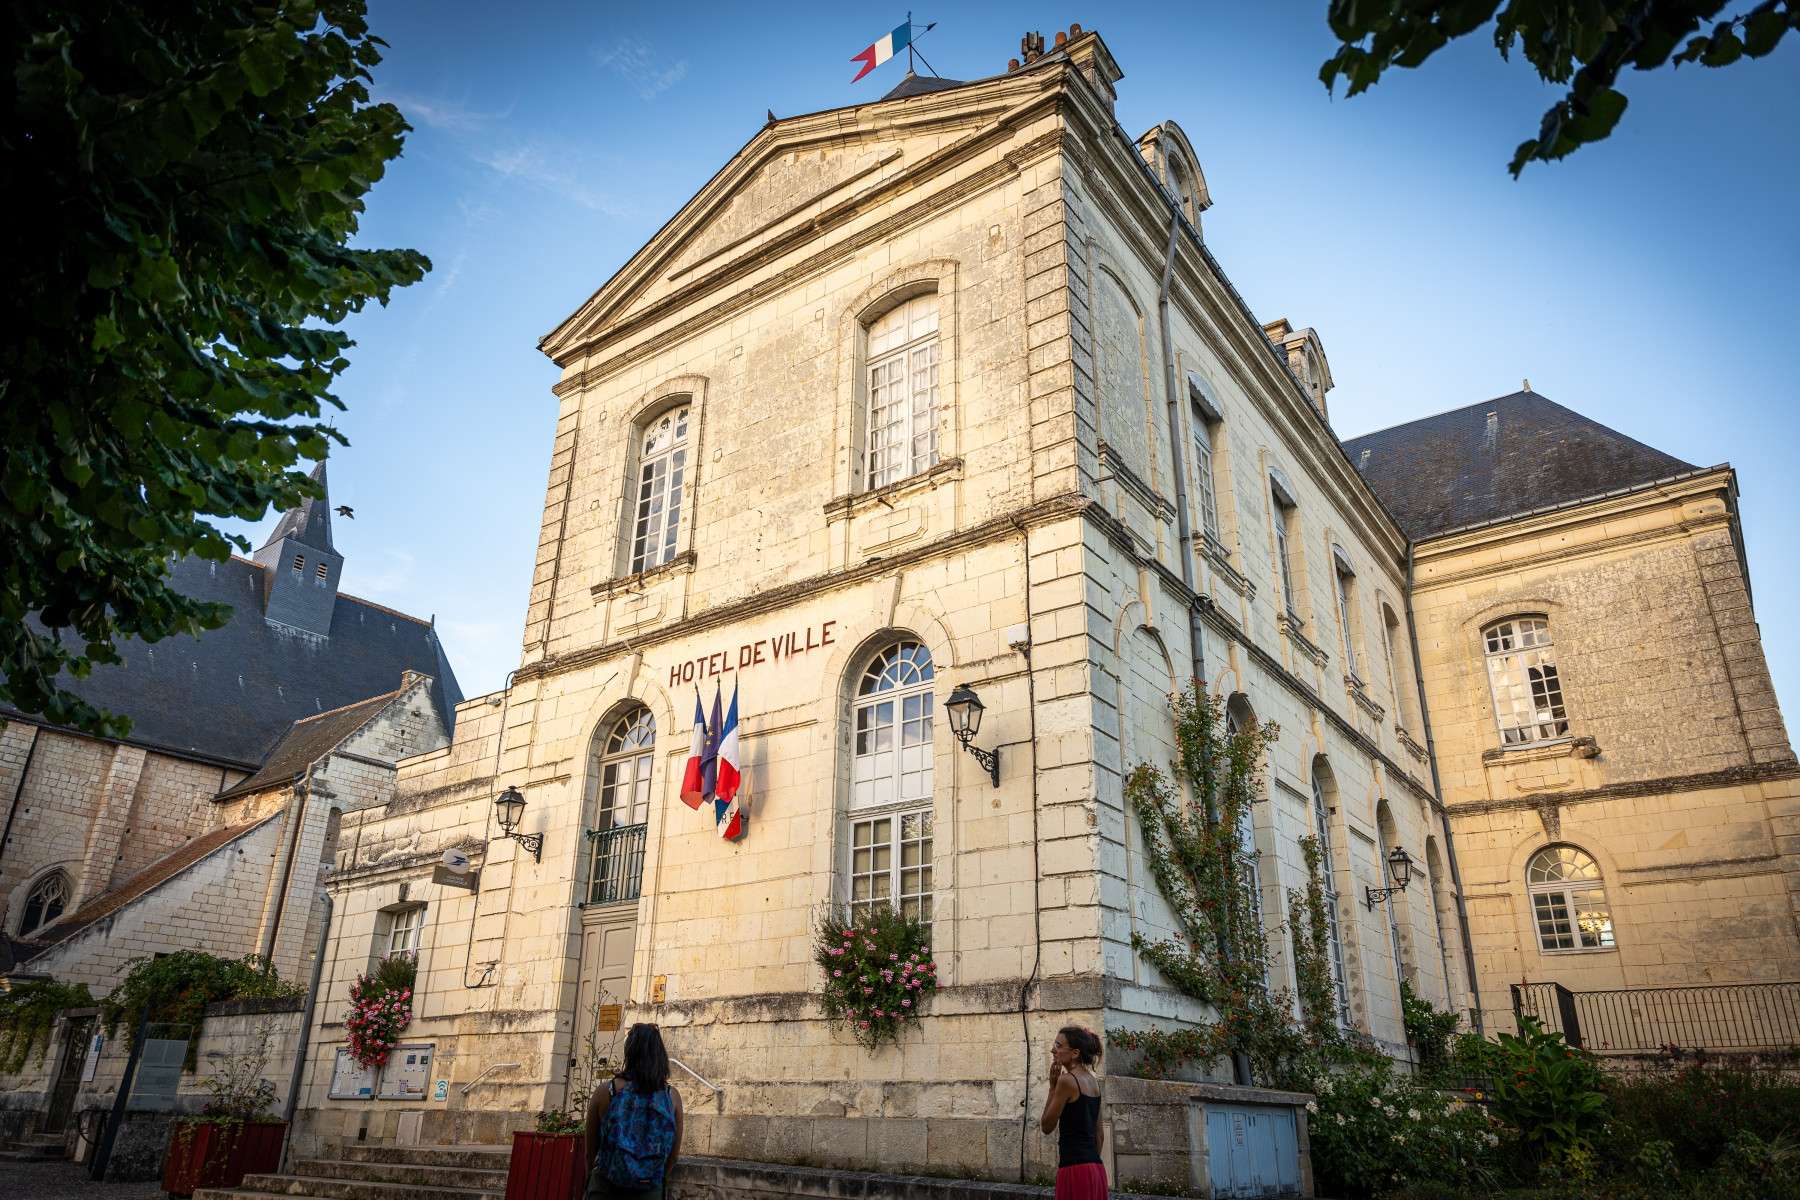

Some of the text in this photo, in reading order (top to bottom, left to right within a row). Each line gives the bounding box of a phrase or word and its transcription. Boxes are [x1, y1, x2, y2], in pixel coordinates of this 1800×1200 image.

[669, 620, 837, 688] HOTEL DE VILLE
